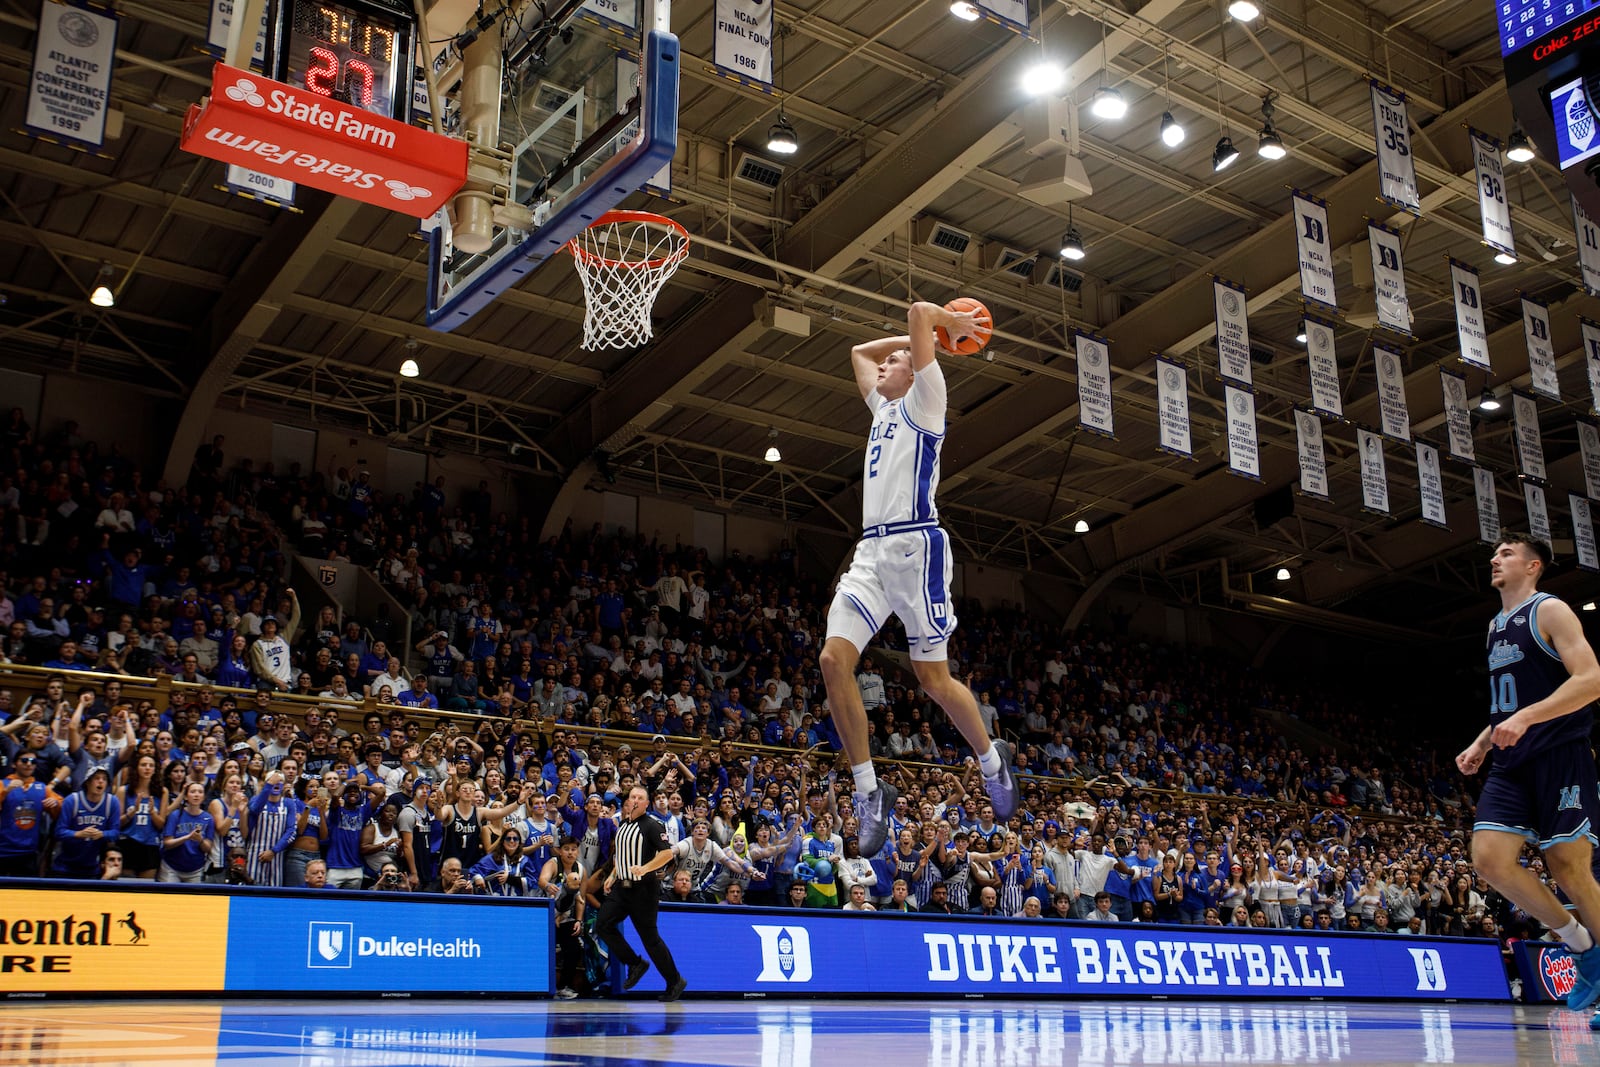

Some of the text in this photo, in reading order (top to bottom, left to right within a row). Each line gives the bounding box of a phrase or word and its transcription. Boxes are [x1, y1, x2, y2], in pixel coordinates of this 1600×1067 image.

[734, 9, 759, 26] NCAA
[1503, 4, 1511, 16] 5
[1505, 20, 1512, 31] 7
[1520, 7, 1536, 23] 22
[1542, 0, 1550, 10] 3
[1508, 3, 1574, 48] 9 6 5 2
[718, 21, 769, 48] FINAL FOUR
[1532, 36, 1569, 61] Coke
[49, 50, 99, 72] ATLANTIC
[733, 53, 756, 70] 1986
[56, 64, 90, 82] COAST
[35, 71, 105, 100] CONFERENCE
[36, 84, 102, 110] CHAMPIONS
[52, 115, 82, 131] 1999
[1384, 125, 1409, 156] 35
[248, 172, 275, 189] 2000
[1482, 173, 1504, 204] 32
[1584, 224, 1598, 250] 11
[1309, 251, 1324, 262] NCAA
[1302, 261, 1318, 275] FINAL
[1222, 320, 1243, 334] ATLANTIC
[1226, 330, 1241, 341] COAST
[1220, 336, 1249, 352] CONFERENCE
[1222, 344, 1249, 360] CHAMPIONS
[1084, 371, 1106, 384] ATLANTIC
[1088, 380, 1103, 391] COAST
[1080, 386, 1110, 402] CONFERENCE
[1160, 410, 1190, 425] CONFERENCE
[1233, 419, 1252, 431] ATLANTIC
[1230, 433, 1256, 448] CONFERENCE
[1236, 428, 1250, 438] COAST
[1231, 442, 1256, 455] CHAMPIONS
[870, 444, 882, 478] 2
[321, 570, 336, 584] 15
[273, 656, 280, 666] 3
[1490, 672, 1518, 714] 10
[1558, 784, 1582, 812] M
[460, 834, 466, 848] 1
[540, 846, 545, 859] 1
[584, 846, 589, 860] 1
[358, 936, 481, 958] DukeHealth
[923, 932, 1345, 989] DUKE BASKETBALL
[1544, 955, 1574, 977] Jerse
